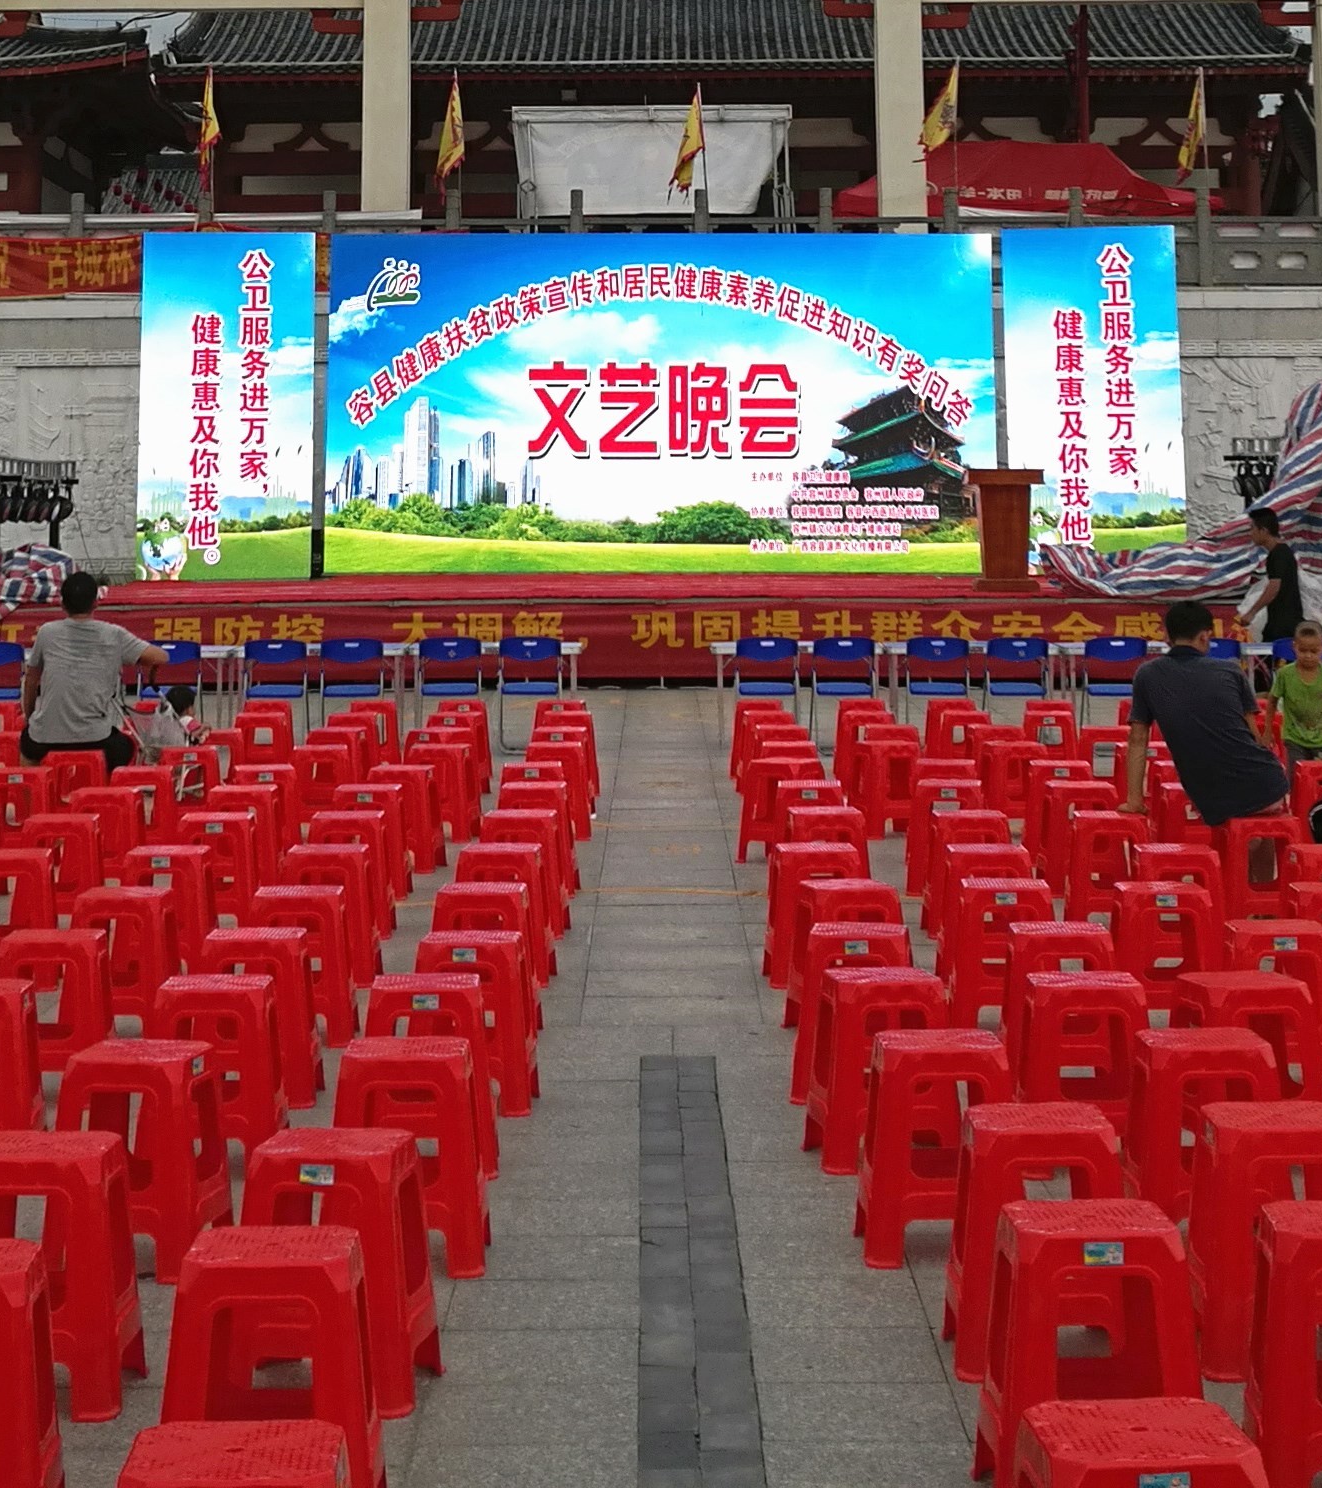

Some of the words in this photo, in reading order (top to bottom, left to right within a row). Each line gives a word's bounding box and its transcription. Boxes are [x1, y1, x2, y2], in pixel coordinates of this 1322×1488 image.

[348, 264, 974, 426] 容县健康扶贫政策宣传和居民健康素养促进知识有奖问答
[527, 361, 801, 458] 文艺晚会
